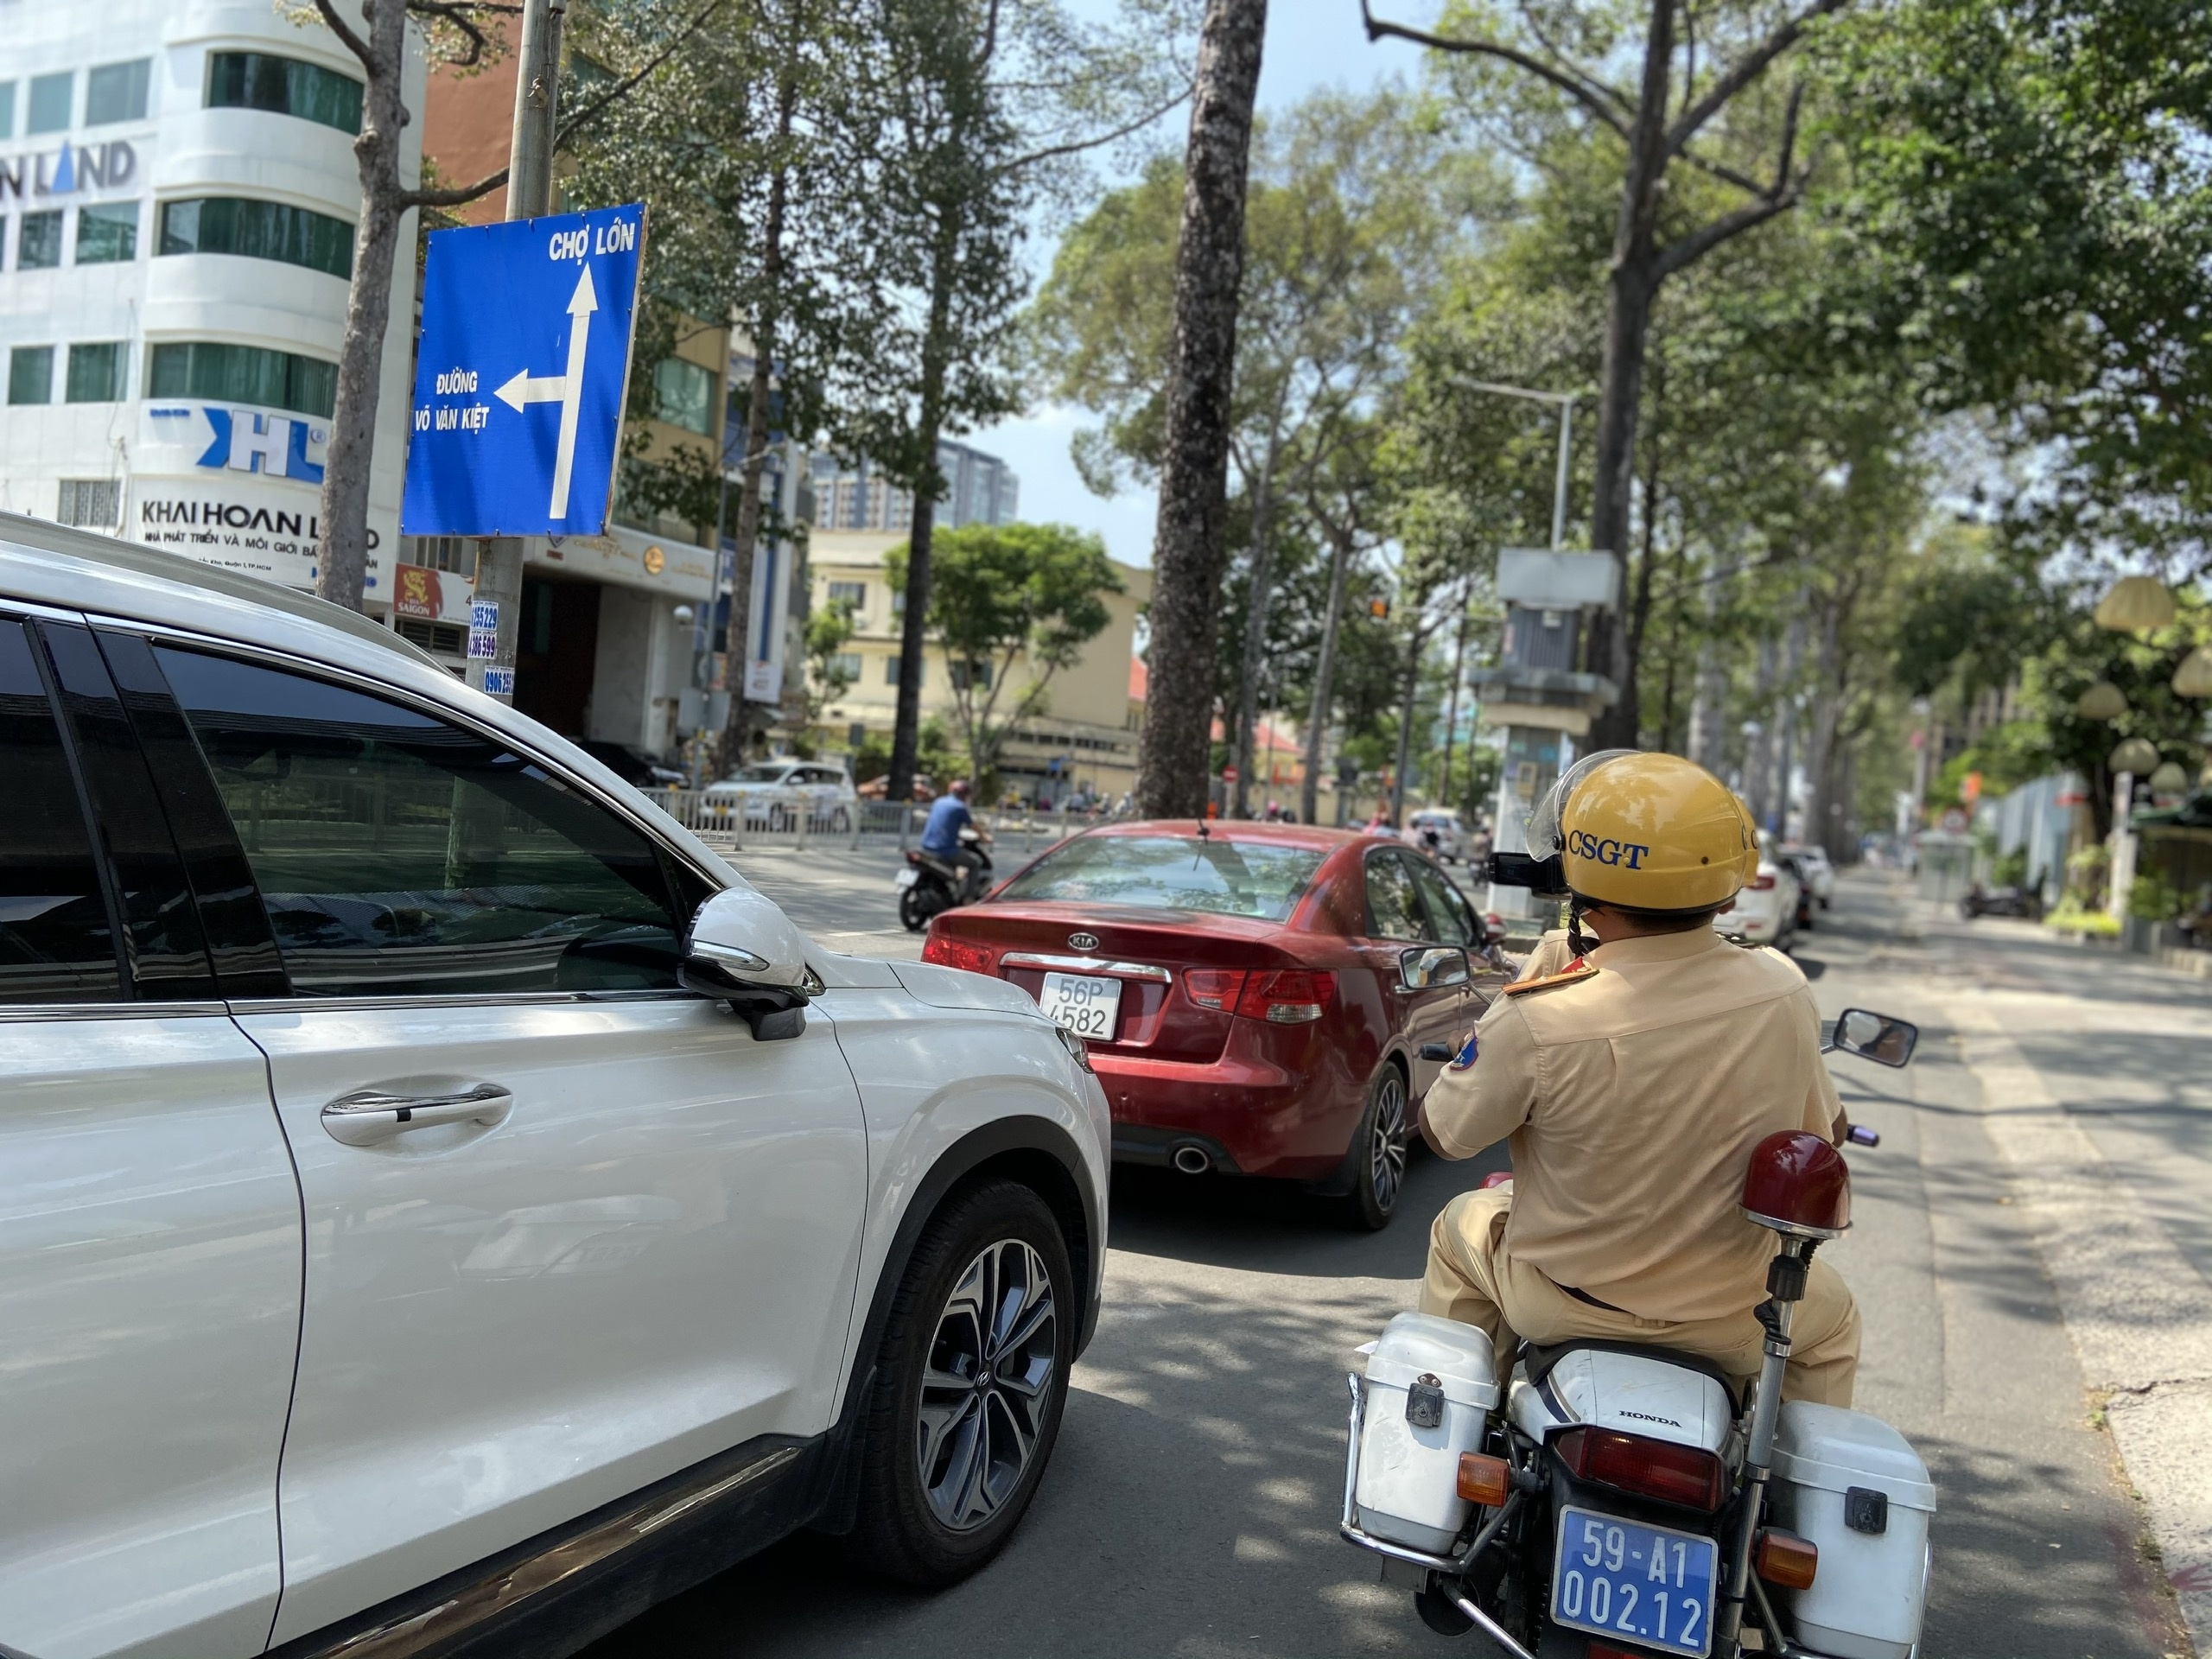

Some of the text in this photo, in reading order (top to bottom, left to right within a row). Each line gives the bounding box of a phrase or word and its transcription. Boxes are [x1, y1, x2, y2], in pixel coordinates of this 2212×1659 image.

[549, 217, 636, 266] CHỢ LỚN
[436, 366, 478, 395] ĐƯỜNG
[416, 402, 490, 435] VÕ VĂN KIỆT
[142, 500, 198, 524] KHAI
[203, 502, 302, 537] HOAN
[163, 530, 187, 543] PHÁT
[224, 532, 240, 547] VÀ
[245, 537, 269, 550] MÔI
[273, 541, 298, 555] GIỚI
[398, 601, 430, 616] SAIGON
[1569, 830, 1649, 870] CSGT
[1072, 936, 1093, 947] KIA
[1058, 978, 1103, 1006] 56P
[1618, 1410, 1682, 1428] HONDA
[1582, 1519, 1687, 1589] 59-A1
[1562, 1569, 1702, 1647] 002.12
